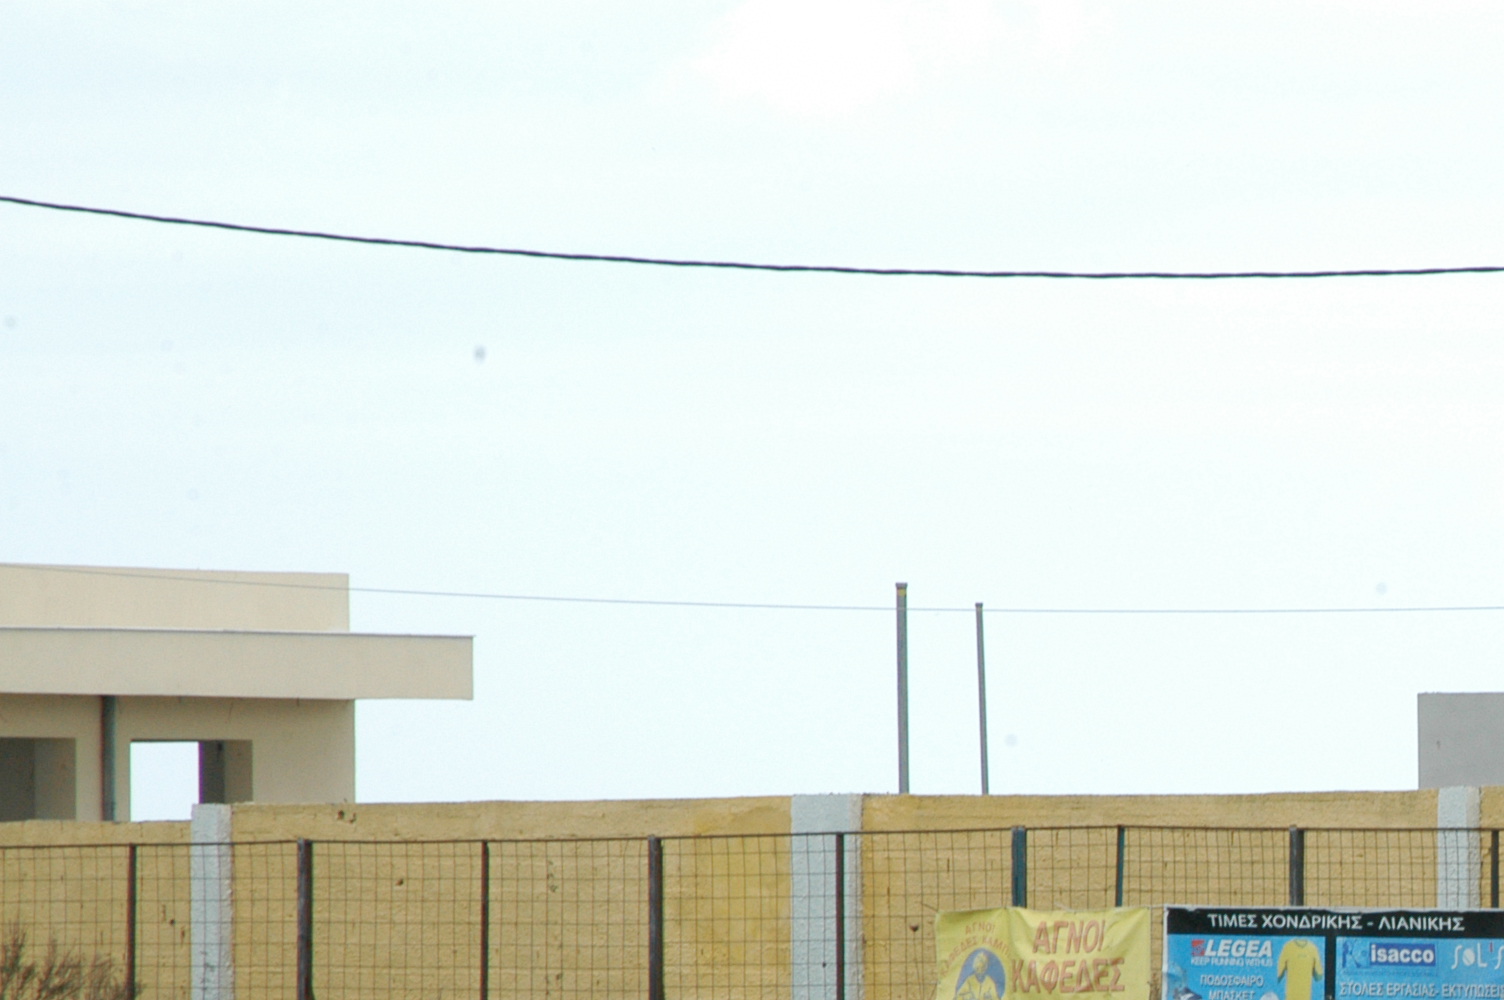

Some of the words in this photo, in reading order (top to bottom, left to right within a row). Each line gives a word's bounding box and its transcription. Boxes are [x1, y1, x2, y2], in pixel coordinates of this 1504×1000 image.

[1207, 914, 1258, 928] ΤΙΜΕΣ
[1262, 914, 1363, 930] ΧΟΝΔΡΙΚΗΣ
[1378, 916, 1465, 931] ΛΙΑΝΙΚΗΣ
[1033, 919, 1106, 954] ΑΓΝΟΙ
[1204, 939, 1273, 957] LEGEA
[1371, 944, 1435, 963] isacco
[1011, 957, 1126, 994] ΚΑΦΕΔΕΣ
[1200, 974, 1264, 987] ΠΟΔΟΣΦΑΙΡΟ
[1209, 990, 1255, 1000] ΜΠΑΣΚΕΤ
[1340, 982, 1384, 996] ΣΤΟΛΕΣ
